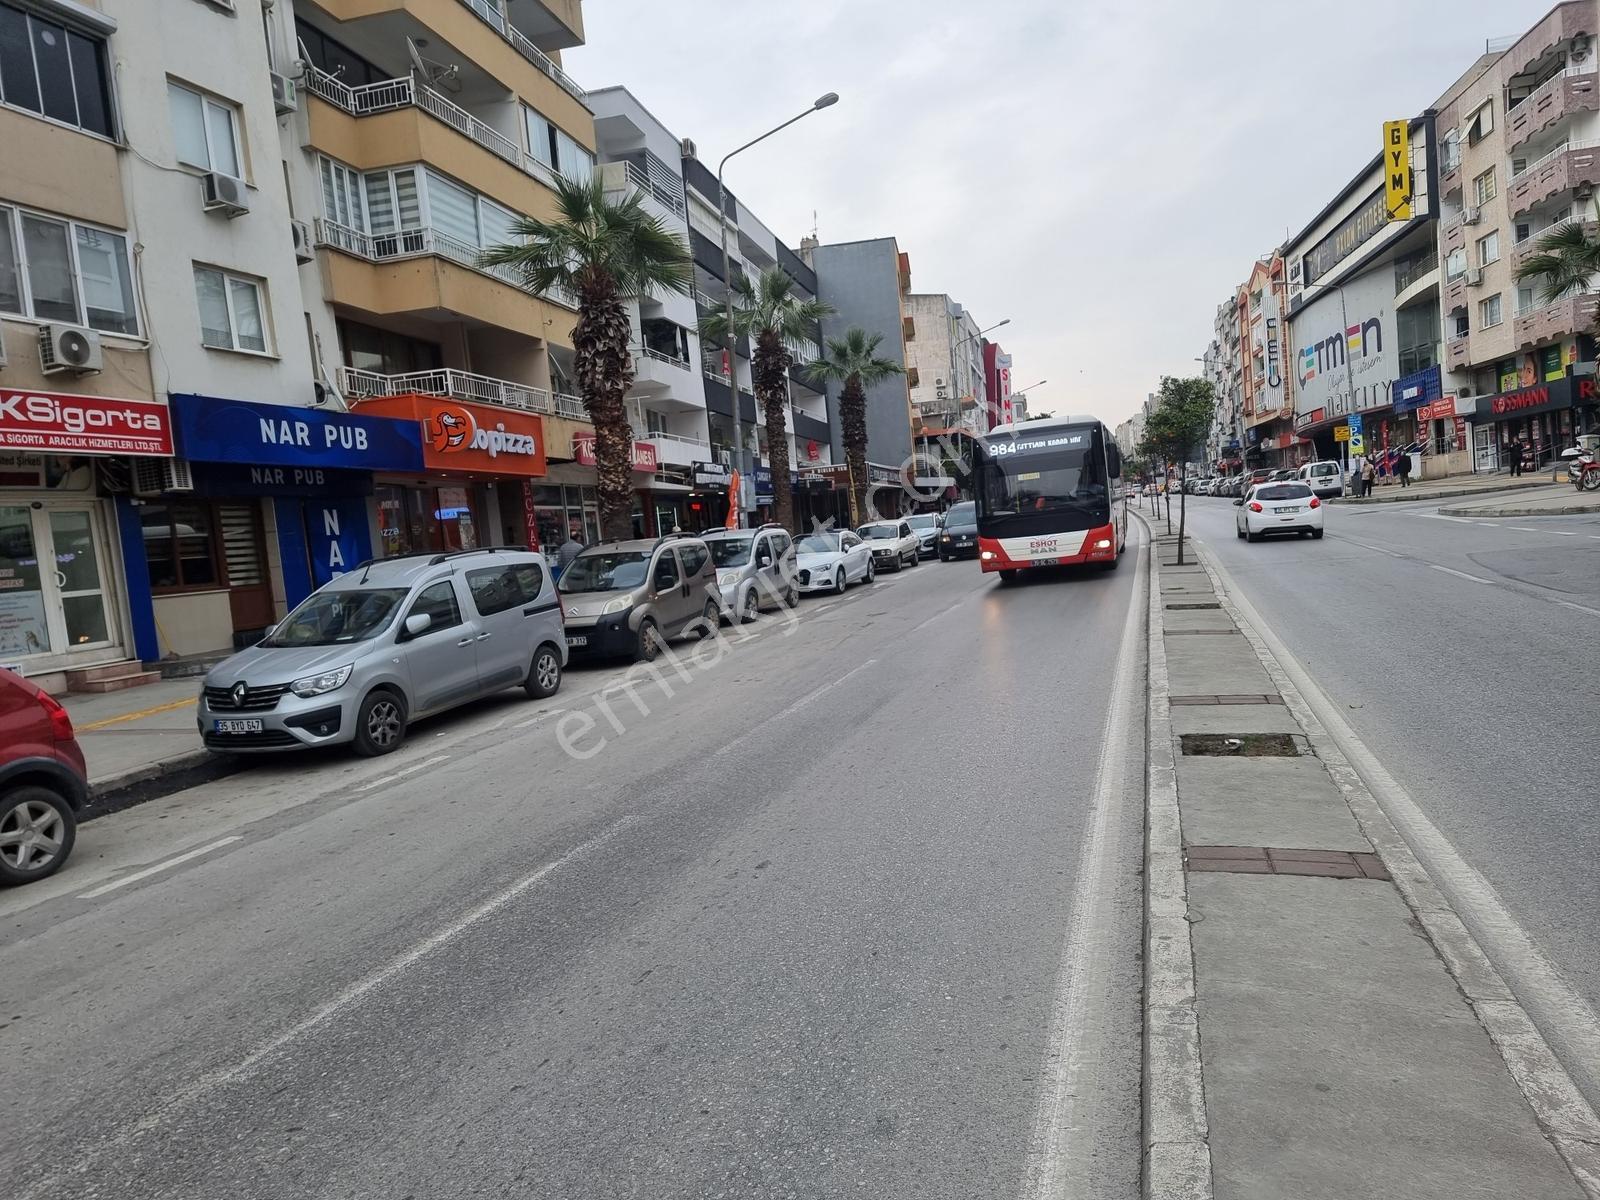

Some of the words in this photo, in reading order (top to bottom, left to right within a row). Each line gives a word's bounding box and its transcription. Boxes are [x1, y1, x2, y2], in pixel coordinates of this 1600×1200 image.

[1391, 128, 1403, 191] GYM
[49, 437, 88, 447] ARACILIK
[260, 418, 311, 446] NAR
[324, 424, 368, 450] PUB
[989, 442, 1017, 457] 984
[250, 467, 285, 484] NAR
[294, 469, 325, 485] PUB
[1029, 539, 1058, 549] ESHOT
